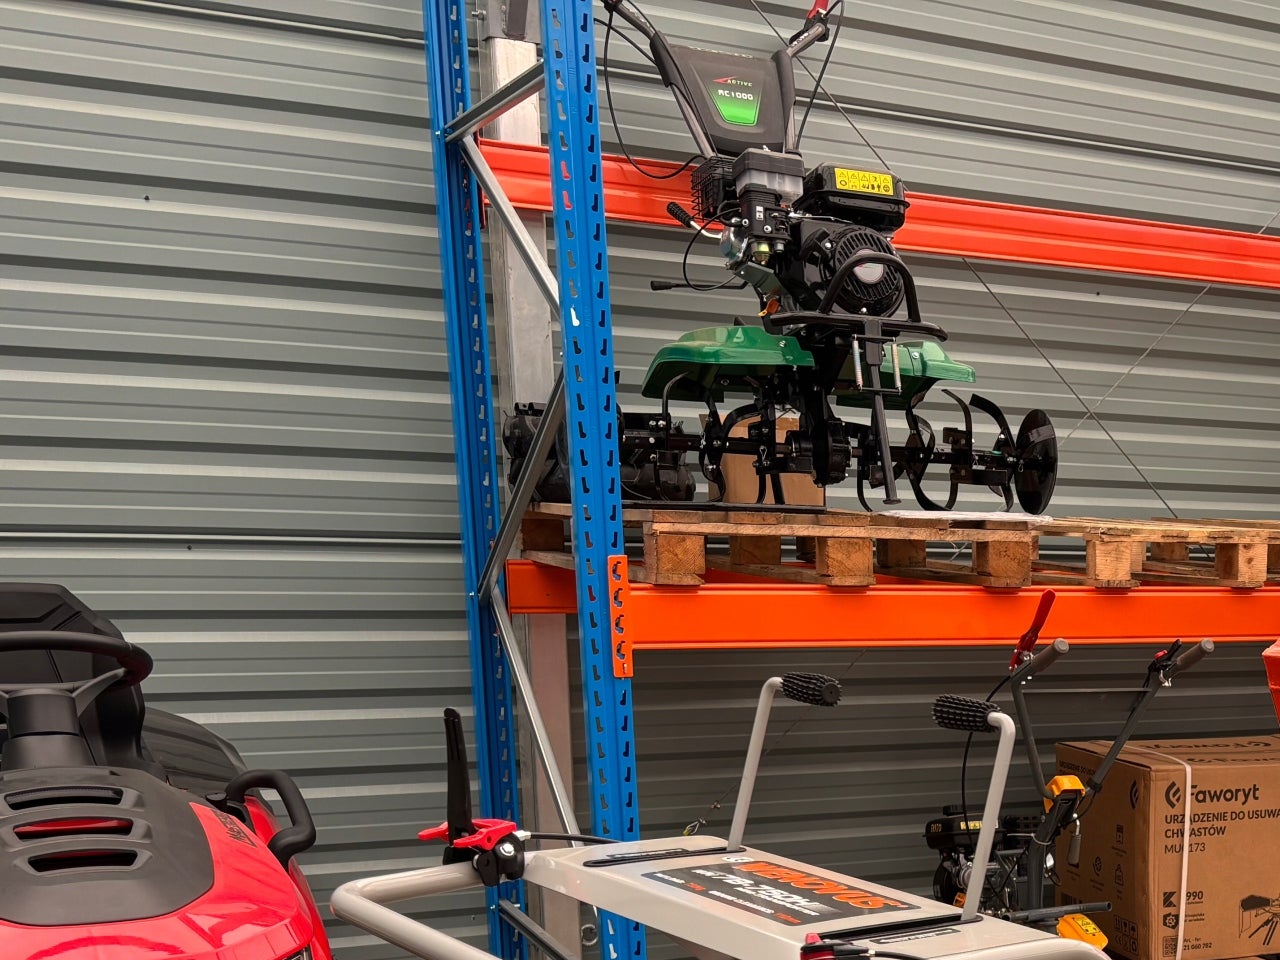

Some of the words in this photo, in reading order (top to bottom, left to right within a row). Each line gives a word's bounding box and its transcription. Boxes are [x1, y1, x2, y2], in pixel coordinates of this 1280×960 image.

[1165, 811, 1228, 824] URZDZENIE
[1230, 810, 1246, 821] DO
[1164, 842, 1206, 854] MU173
